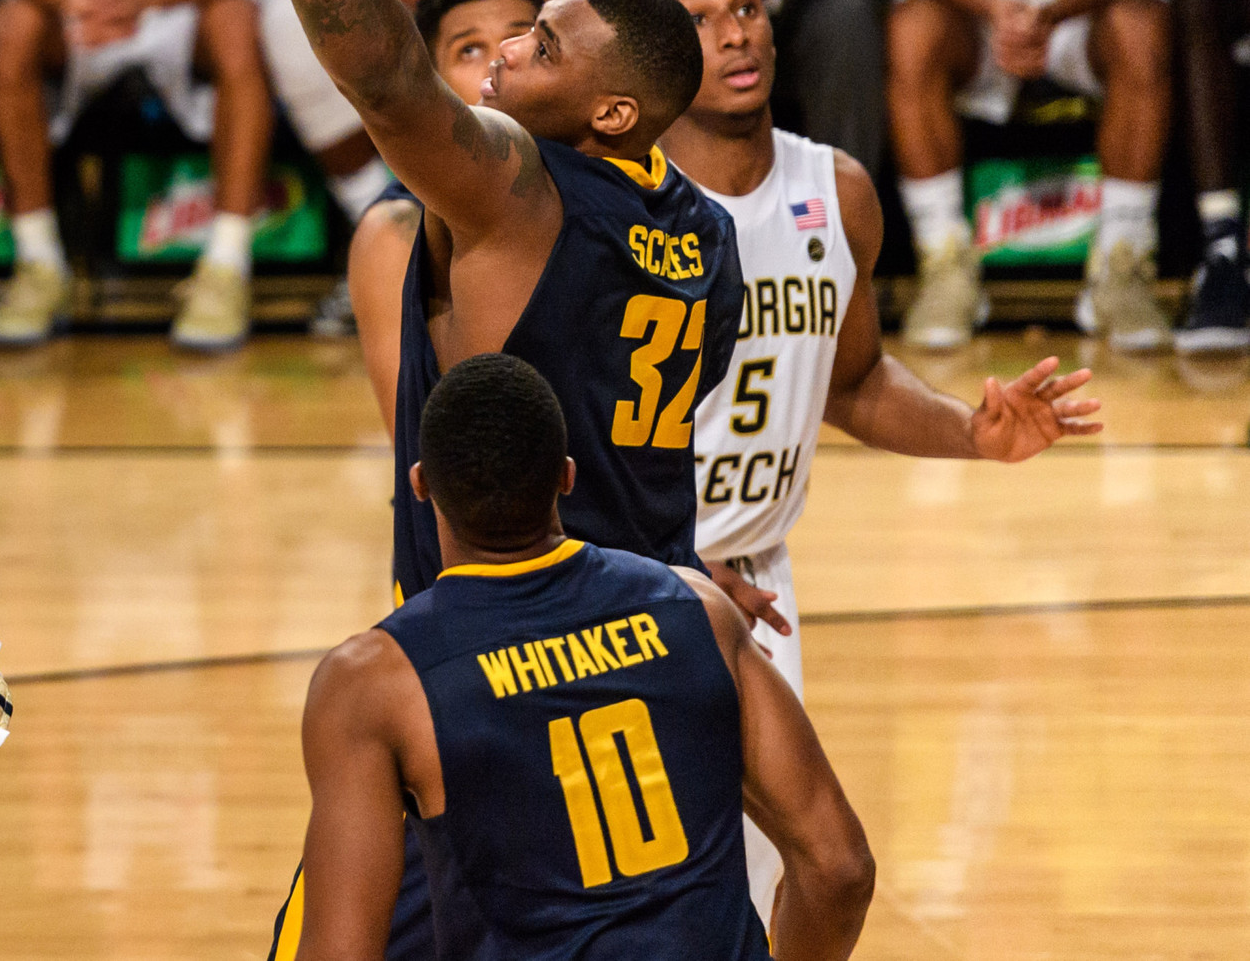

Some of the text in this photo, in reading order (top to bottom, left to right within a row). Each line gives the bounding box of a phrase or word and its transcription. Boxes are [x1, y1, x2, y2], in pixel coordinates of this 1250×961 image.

[730, 354, 779, 437] 5
[695, 444, 802, 505] ECH
[477, 612, 670, 699] WHITAKER
[548, 698, 690, 889] 10
